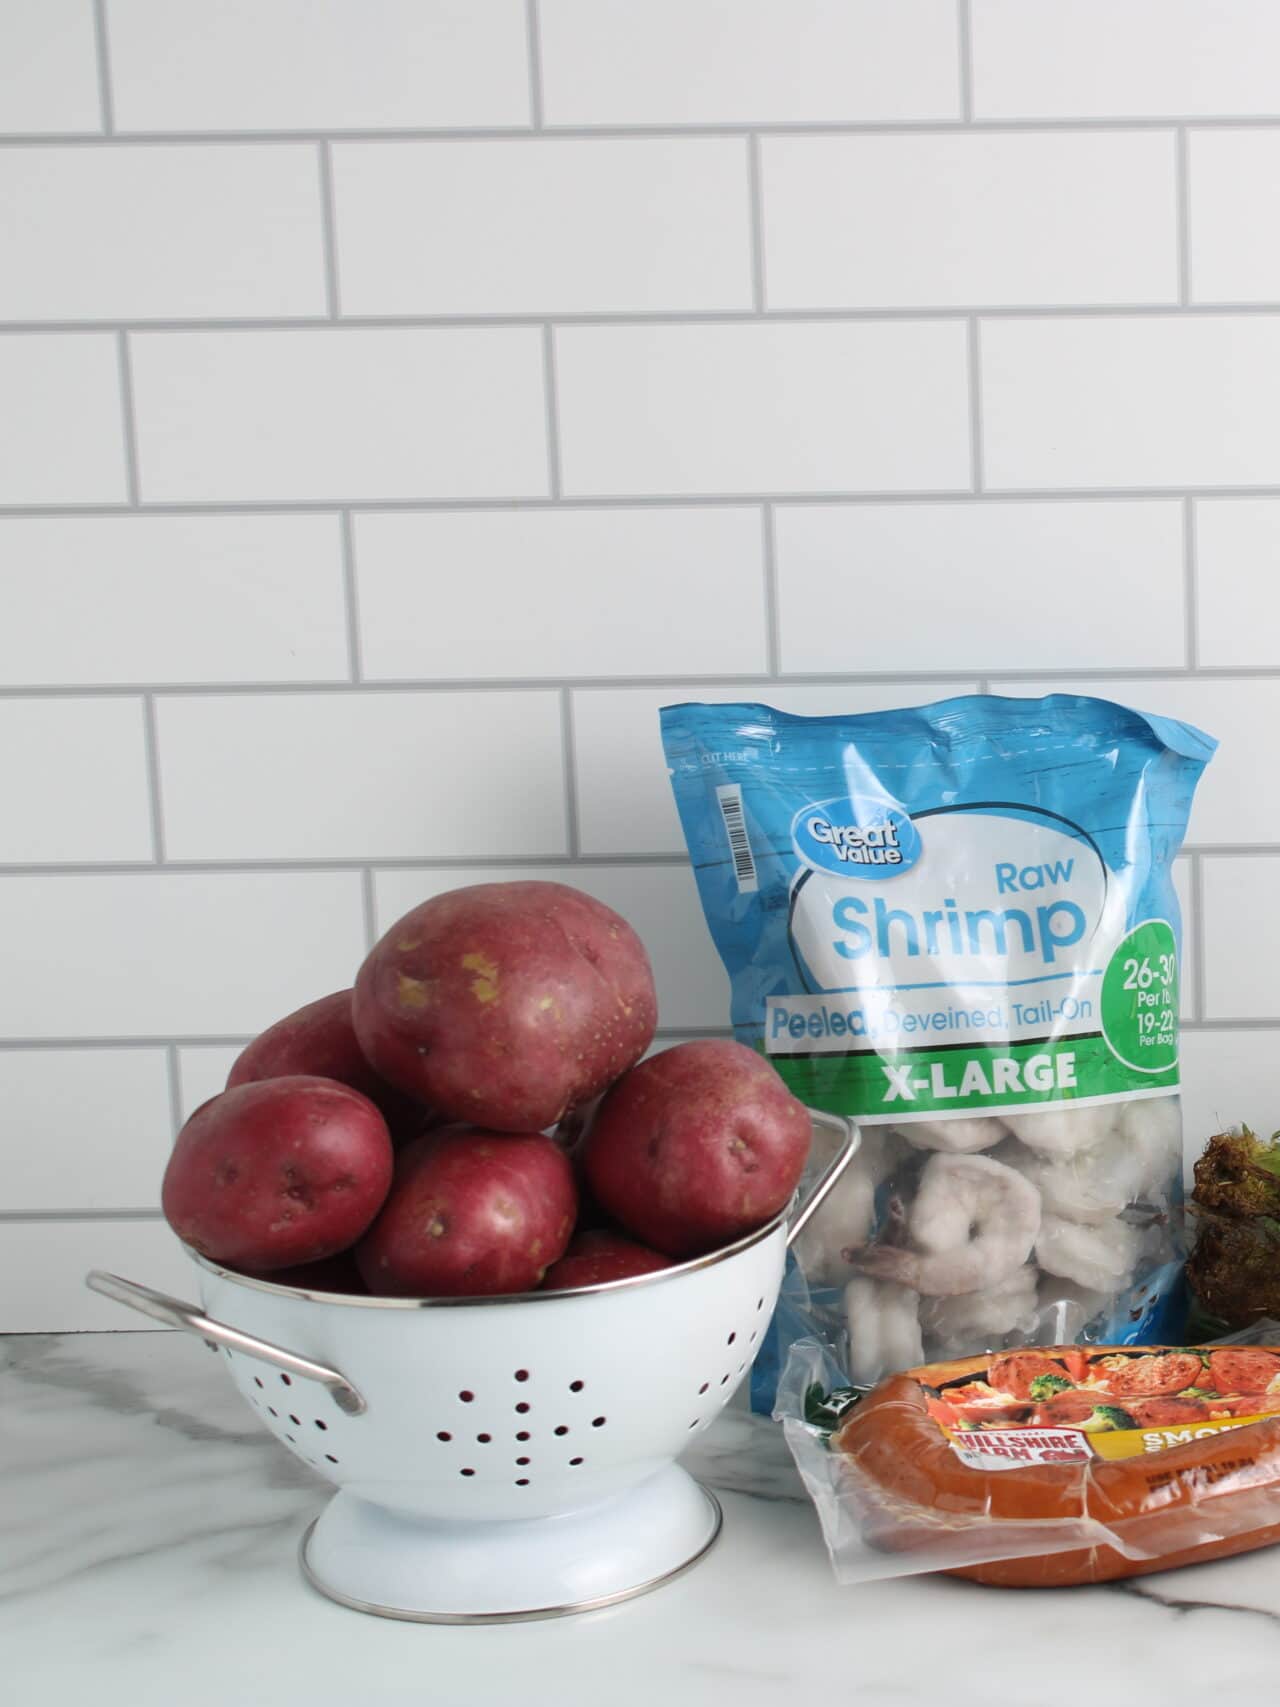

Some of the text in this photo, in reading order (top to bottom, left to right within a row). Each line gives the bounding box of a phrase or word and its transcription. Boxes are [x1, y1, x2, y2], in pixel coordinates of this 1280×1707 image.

[808, 816, 899, 848] Great
[833, 843, 902, 864] Value
[995, 859, 1074, 894] Raw
[832, 897, 1086, 964] Shrimp
[1123, 953, 1175, 990] 26-30
[1012, 997, 1092, 1026] Tail-On
[1138, 991, 1158, 1007] Per
[1137, 1009, 1174, 1034] 19-22
[1140, 1032, 1174, 1047] Per Bag
[880, 1051, 1077, 1101] X-LARGE
[957, 1433, 1083, 1449] HILLSHIRE
